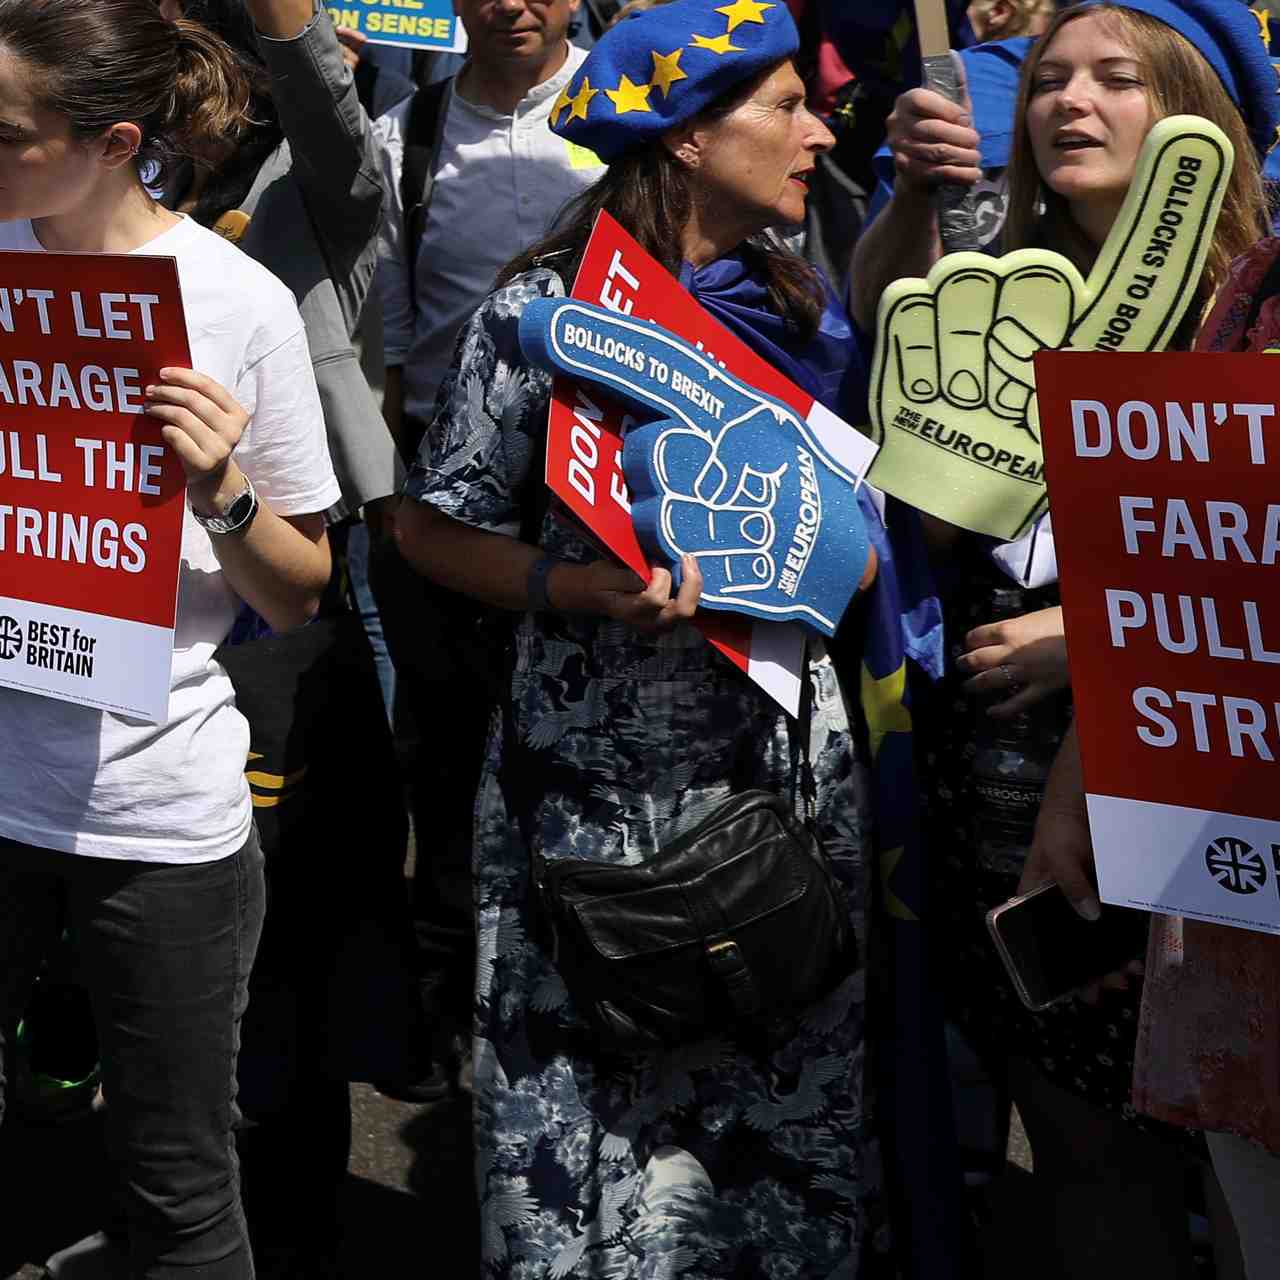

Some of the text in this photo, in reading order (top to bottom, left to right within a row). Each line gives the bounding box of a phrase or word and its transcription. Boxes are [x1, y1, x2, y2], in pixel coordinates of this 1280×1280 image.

[365, 12, 451, 39] SENSE
[1095, 156, 1202, 351] BOLLOCKS TO BORI
[71, 291, 161, 342] LET
[564, 324, 725, 419] BOLLOCKS TO BREXIT
[894, 415, 919, 431] NEW
[899, 406, 922, 421] THE
[1070, 399, 1276, 465] DON'T
[75, 438, 165, 496] THE
[787, 445, 818, 570] EUROPEAN
[26, 620, 97, 654] BEST for
[1104, 588, 1280, 664] PULL
[26, 643, 94, 679] BRITAIN
